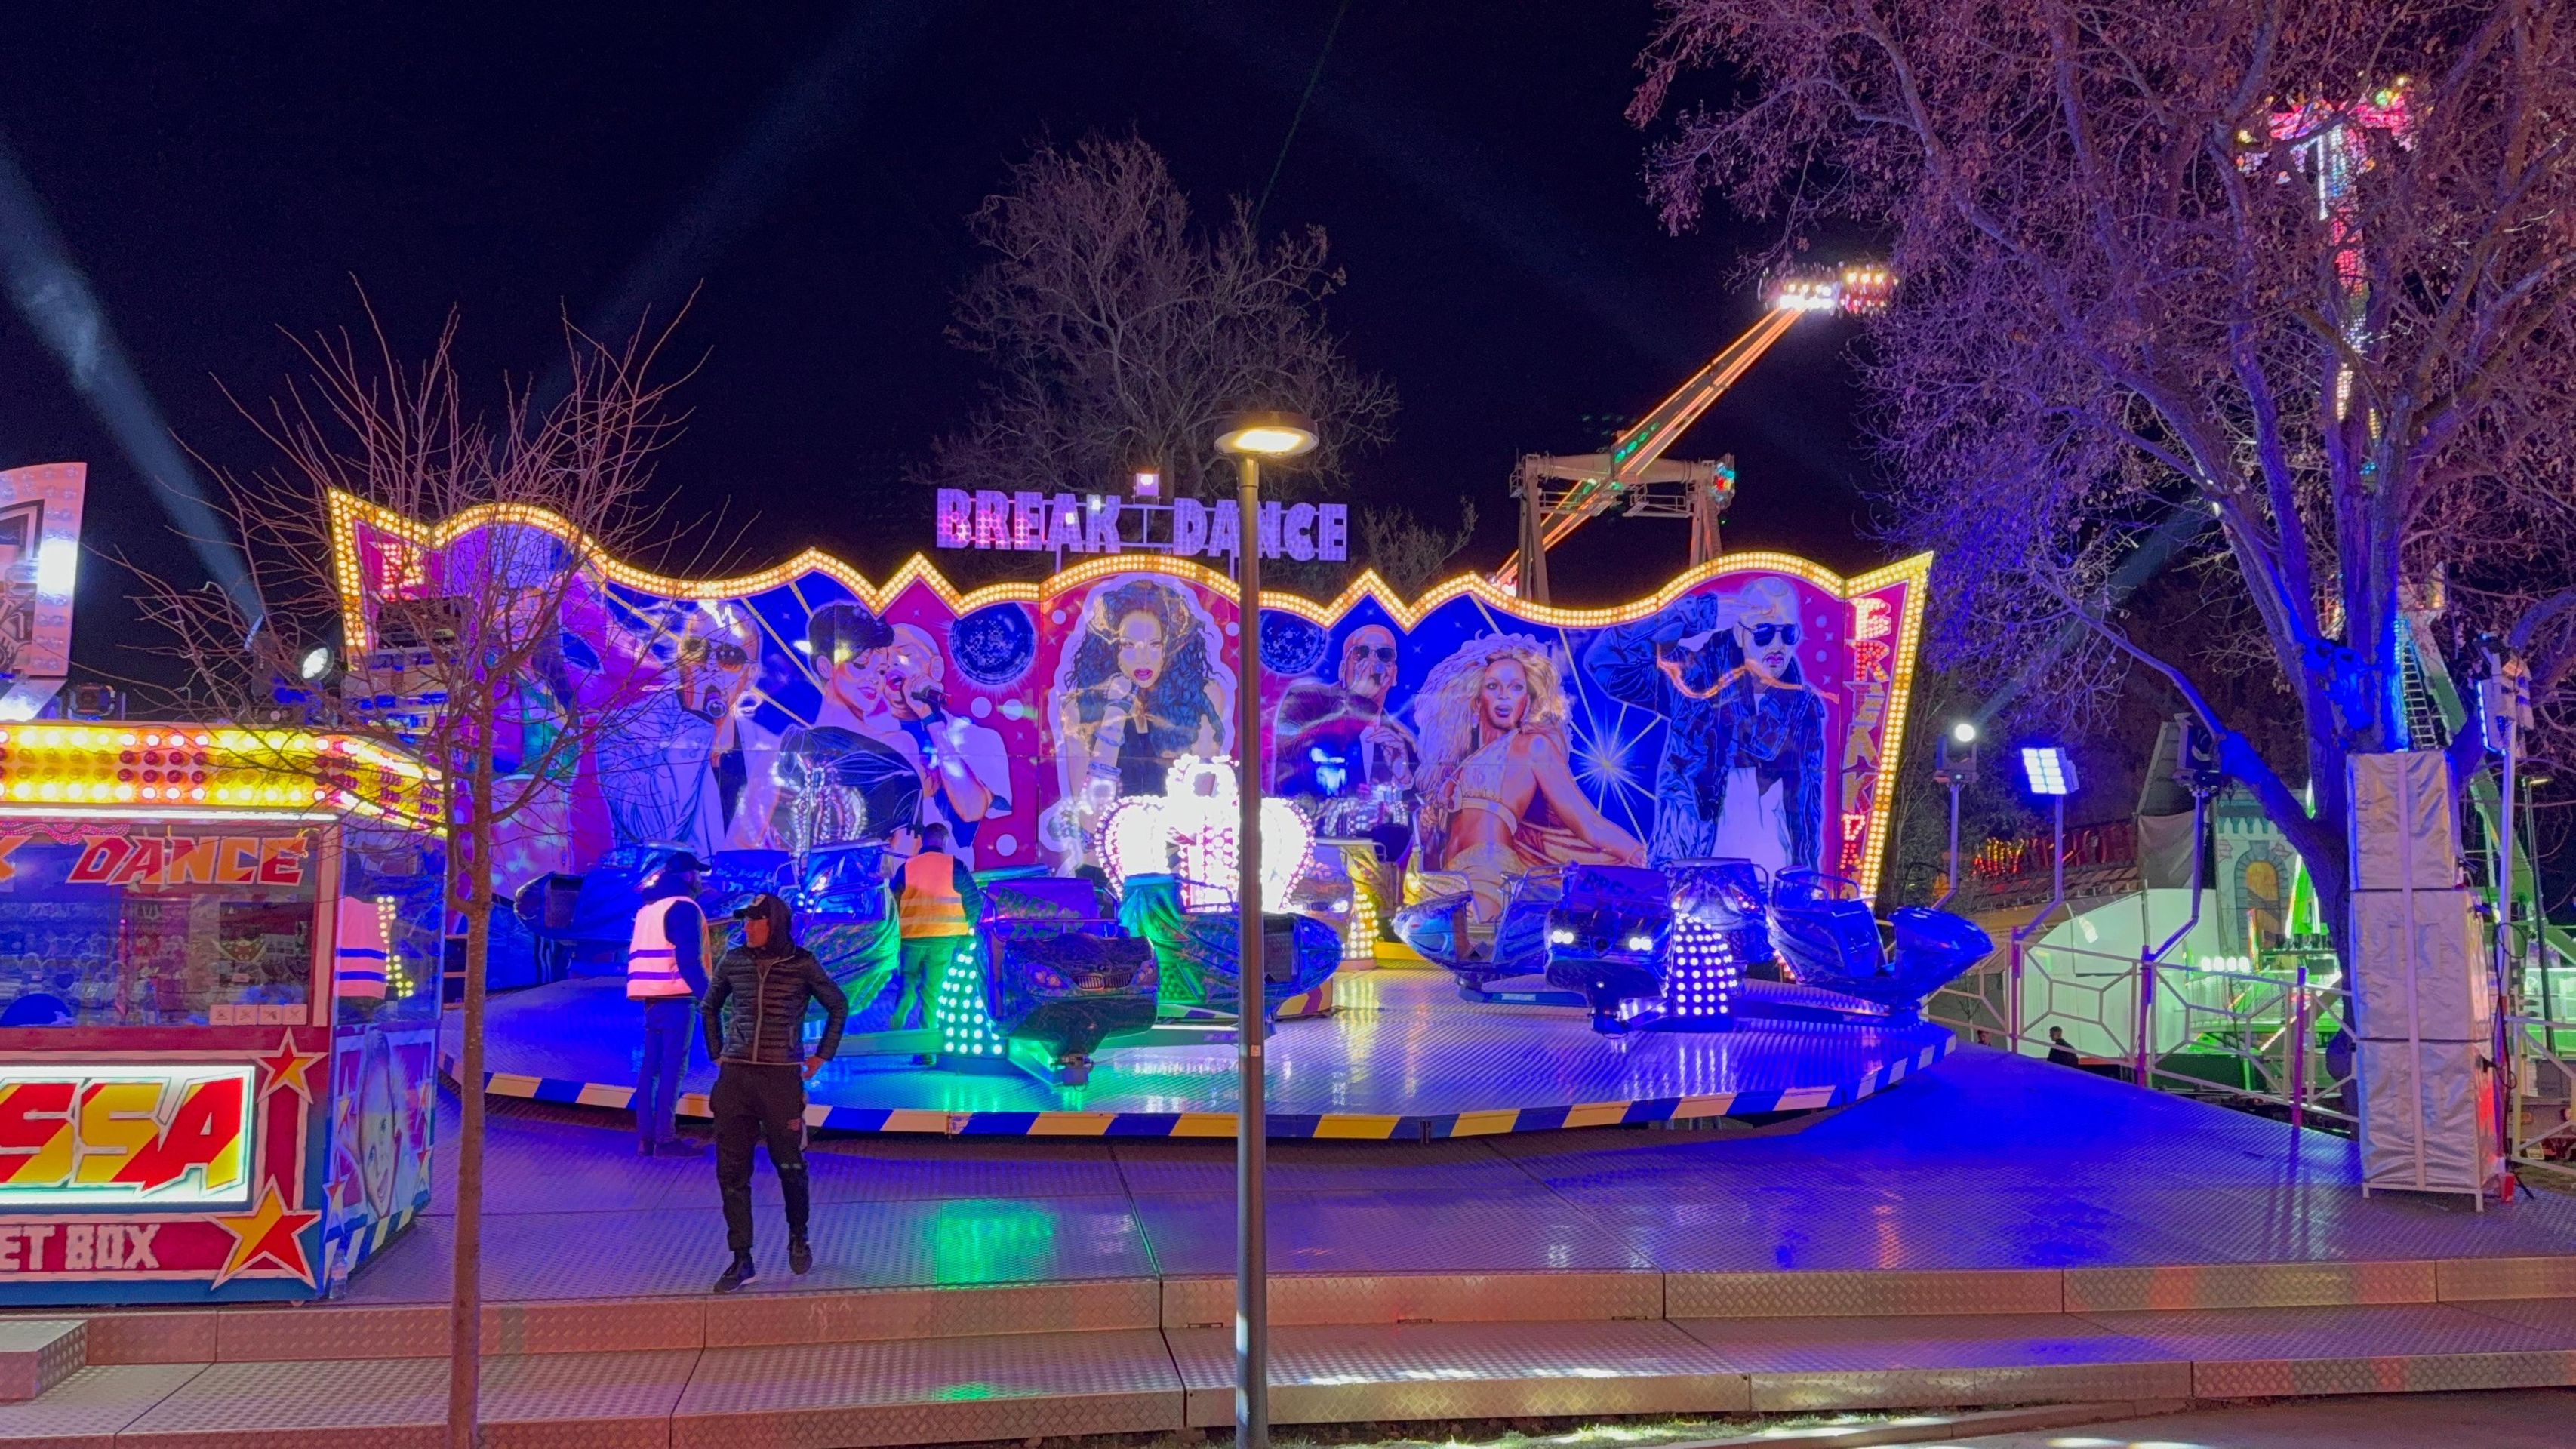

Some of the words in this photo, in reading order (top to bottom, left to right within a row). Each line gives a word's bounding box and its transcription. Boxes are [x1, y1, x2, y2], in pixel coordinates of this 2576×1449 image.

[937, 488, 1121, 553] BREAK
[1173, 497, 1347, 561] DANCE
[66, 835, 308, 886] DANCE
[65, 1223, 161, 1270] BOX
